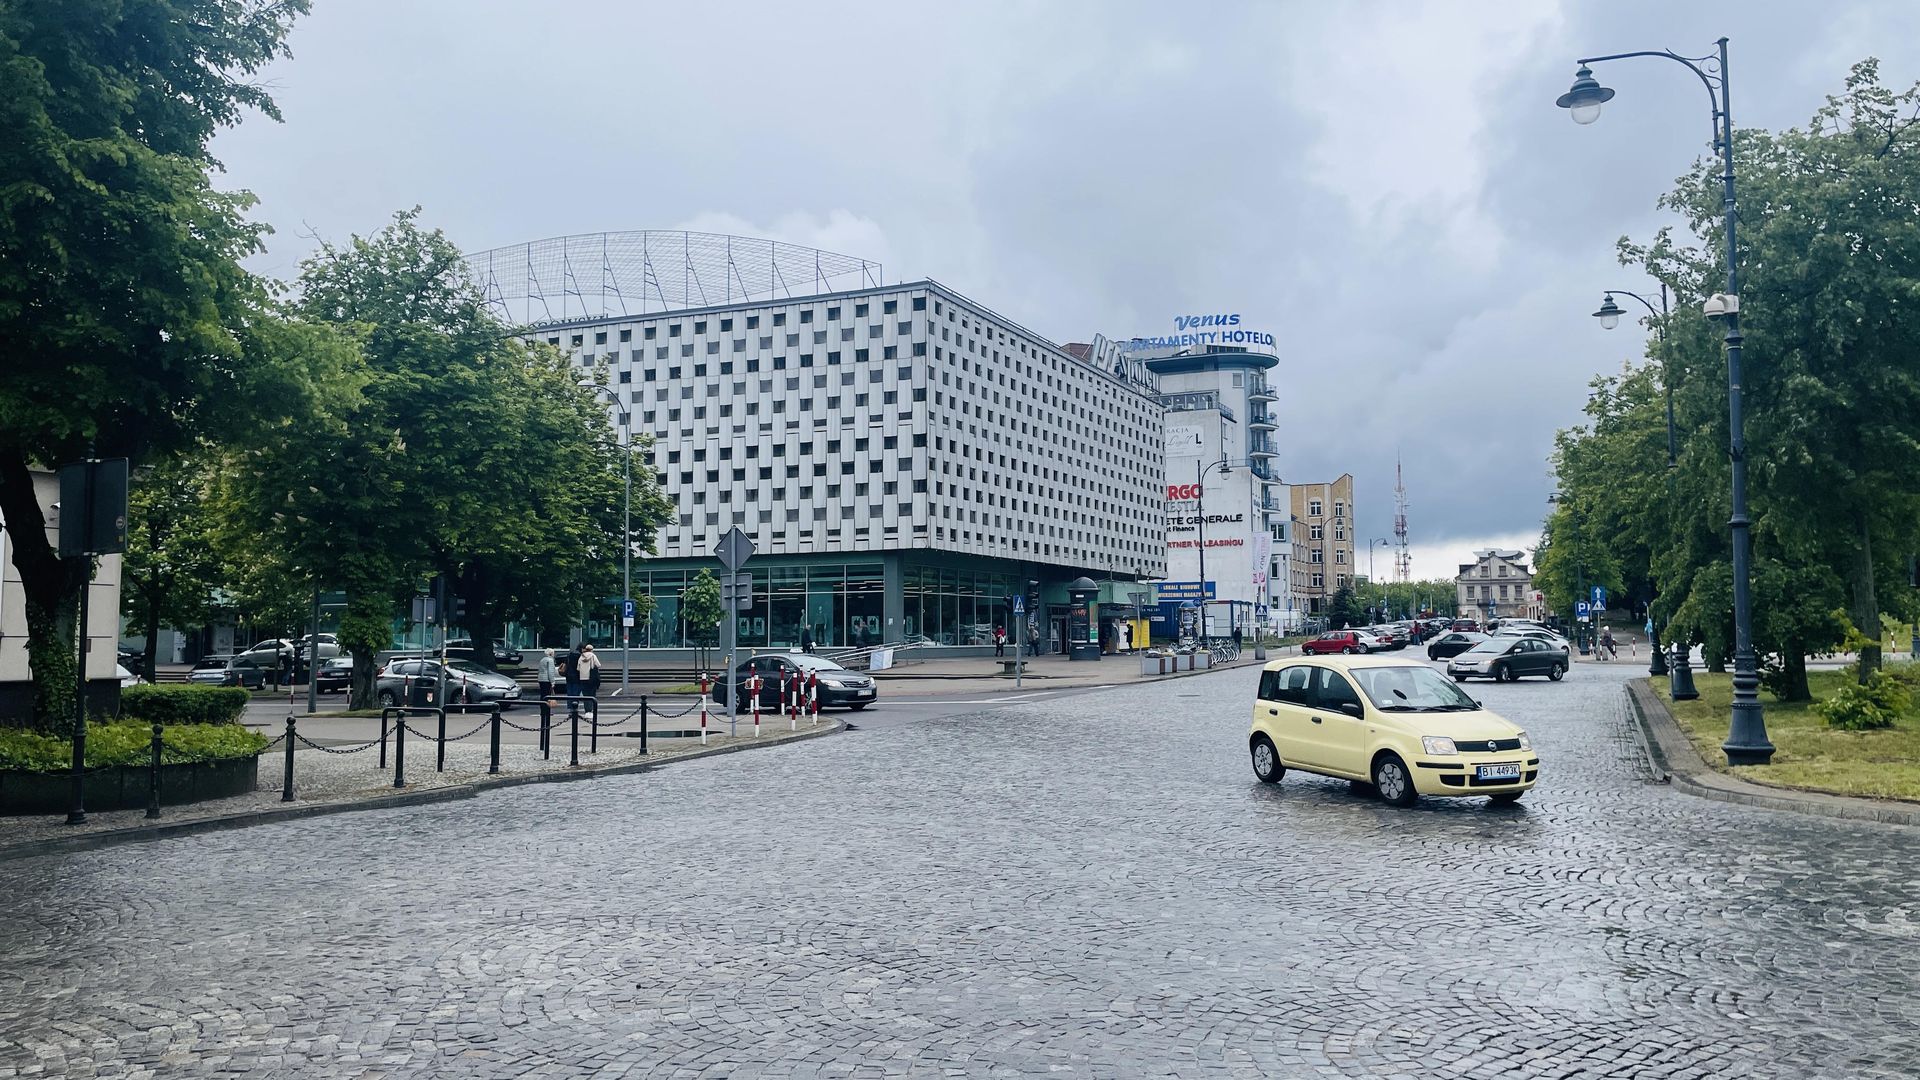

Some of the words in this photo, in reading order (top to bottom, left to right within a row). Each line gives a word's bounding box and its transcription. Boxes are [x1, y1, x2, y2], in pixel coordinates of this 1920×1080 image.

[1222, 330, 1275, 346] HOTELO
[1166, 483, 1202, 501] RGO
[1166, 501, 1204, 513] ESTIA
[1166, 516, 1184, 525] ETE
[1186, 514, 1243, 525] GENERALE
[1167, 540, 1192, 549] RTNER
[1203, 538, 1244, 548] LEASINGU
[625, 602, 633, 616] P
[1578, 602, 1586, 612] P
